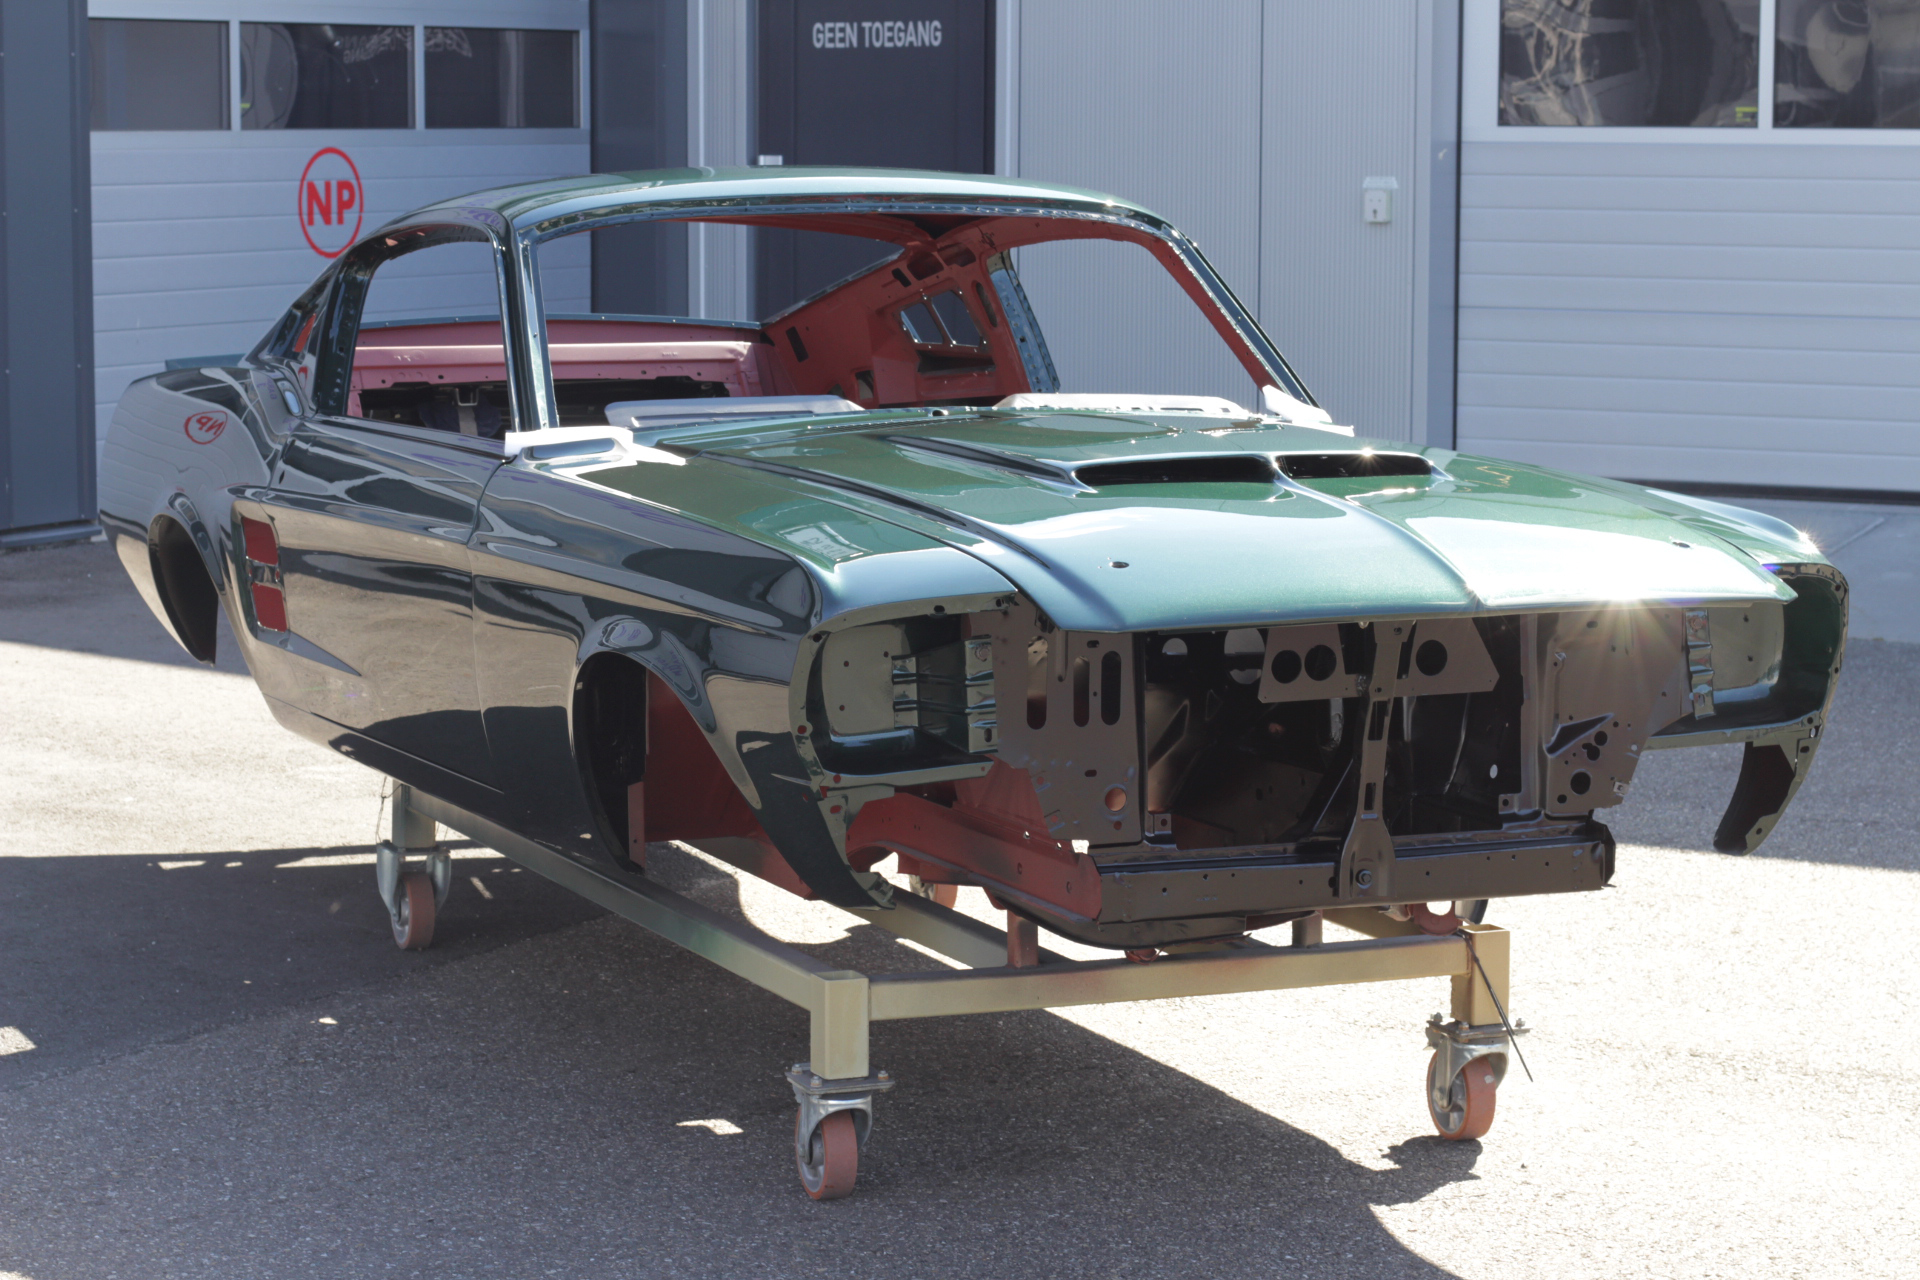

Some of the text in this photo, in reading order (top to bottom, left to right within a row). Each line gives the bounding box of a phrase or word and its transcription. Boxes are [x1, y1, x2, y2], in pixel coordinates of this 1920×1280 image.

[812, 20, 942, 49] GEEN TOEGANG
[306, 179, 356, 227] NP
